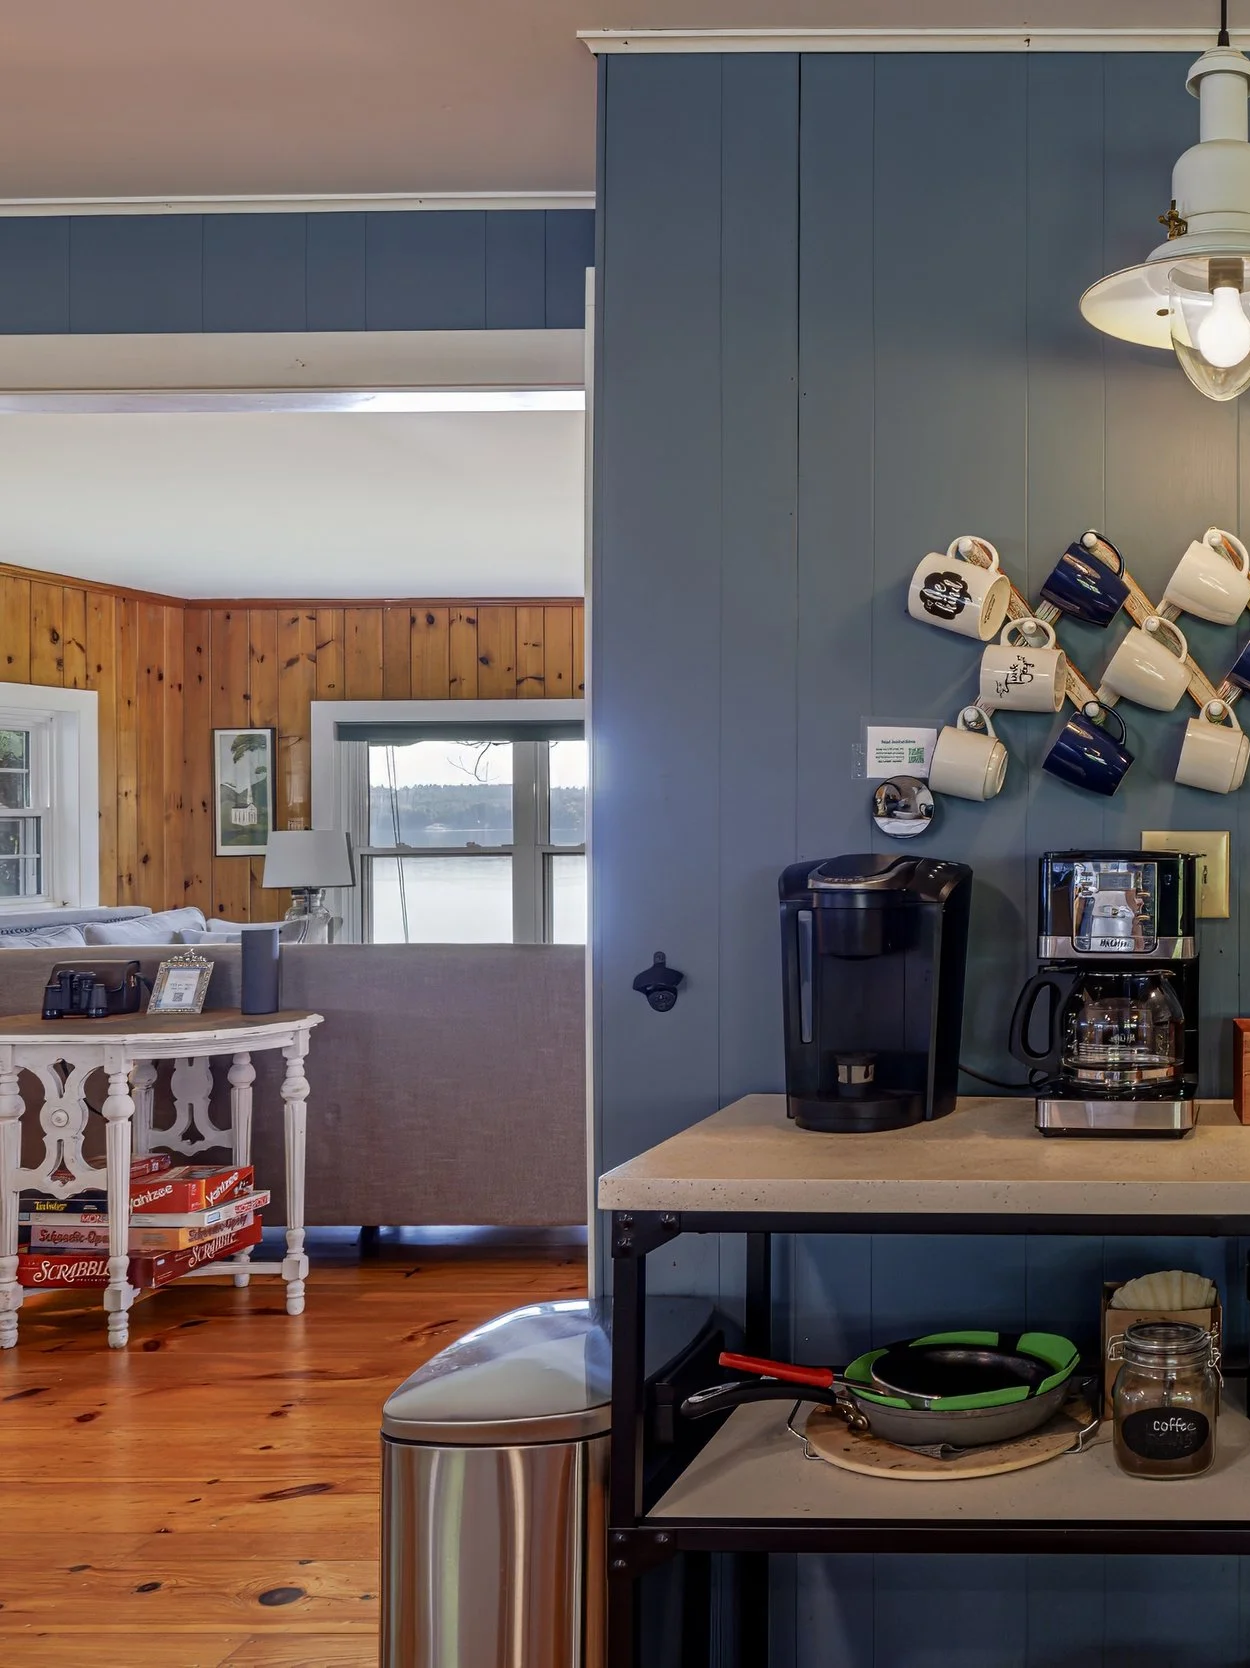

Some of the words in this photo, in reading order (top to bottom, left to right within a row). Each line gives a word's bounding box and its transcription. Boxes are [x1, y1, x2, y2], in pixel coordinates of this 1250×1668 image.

[934, 579, 963, 613] kind
[33, 1260, 110, 1283] SCRABBL
[1153, 1417, 1197, 1432] coffee
